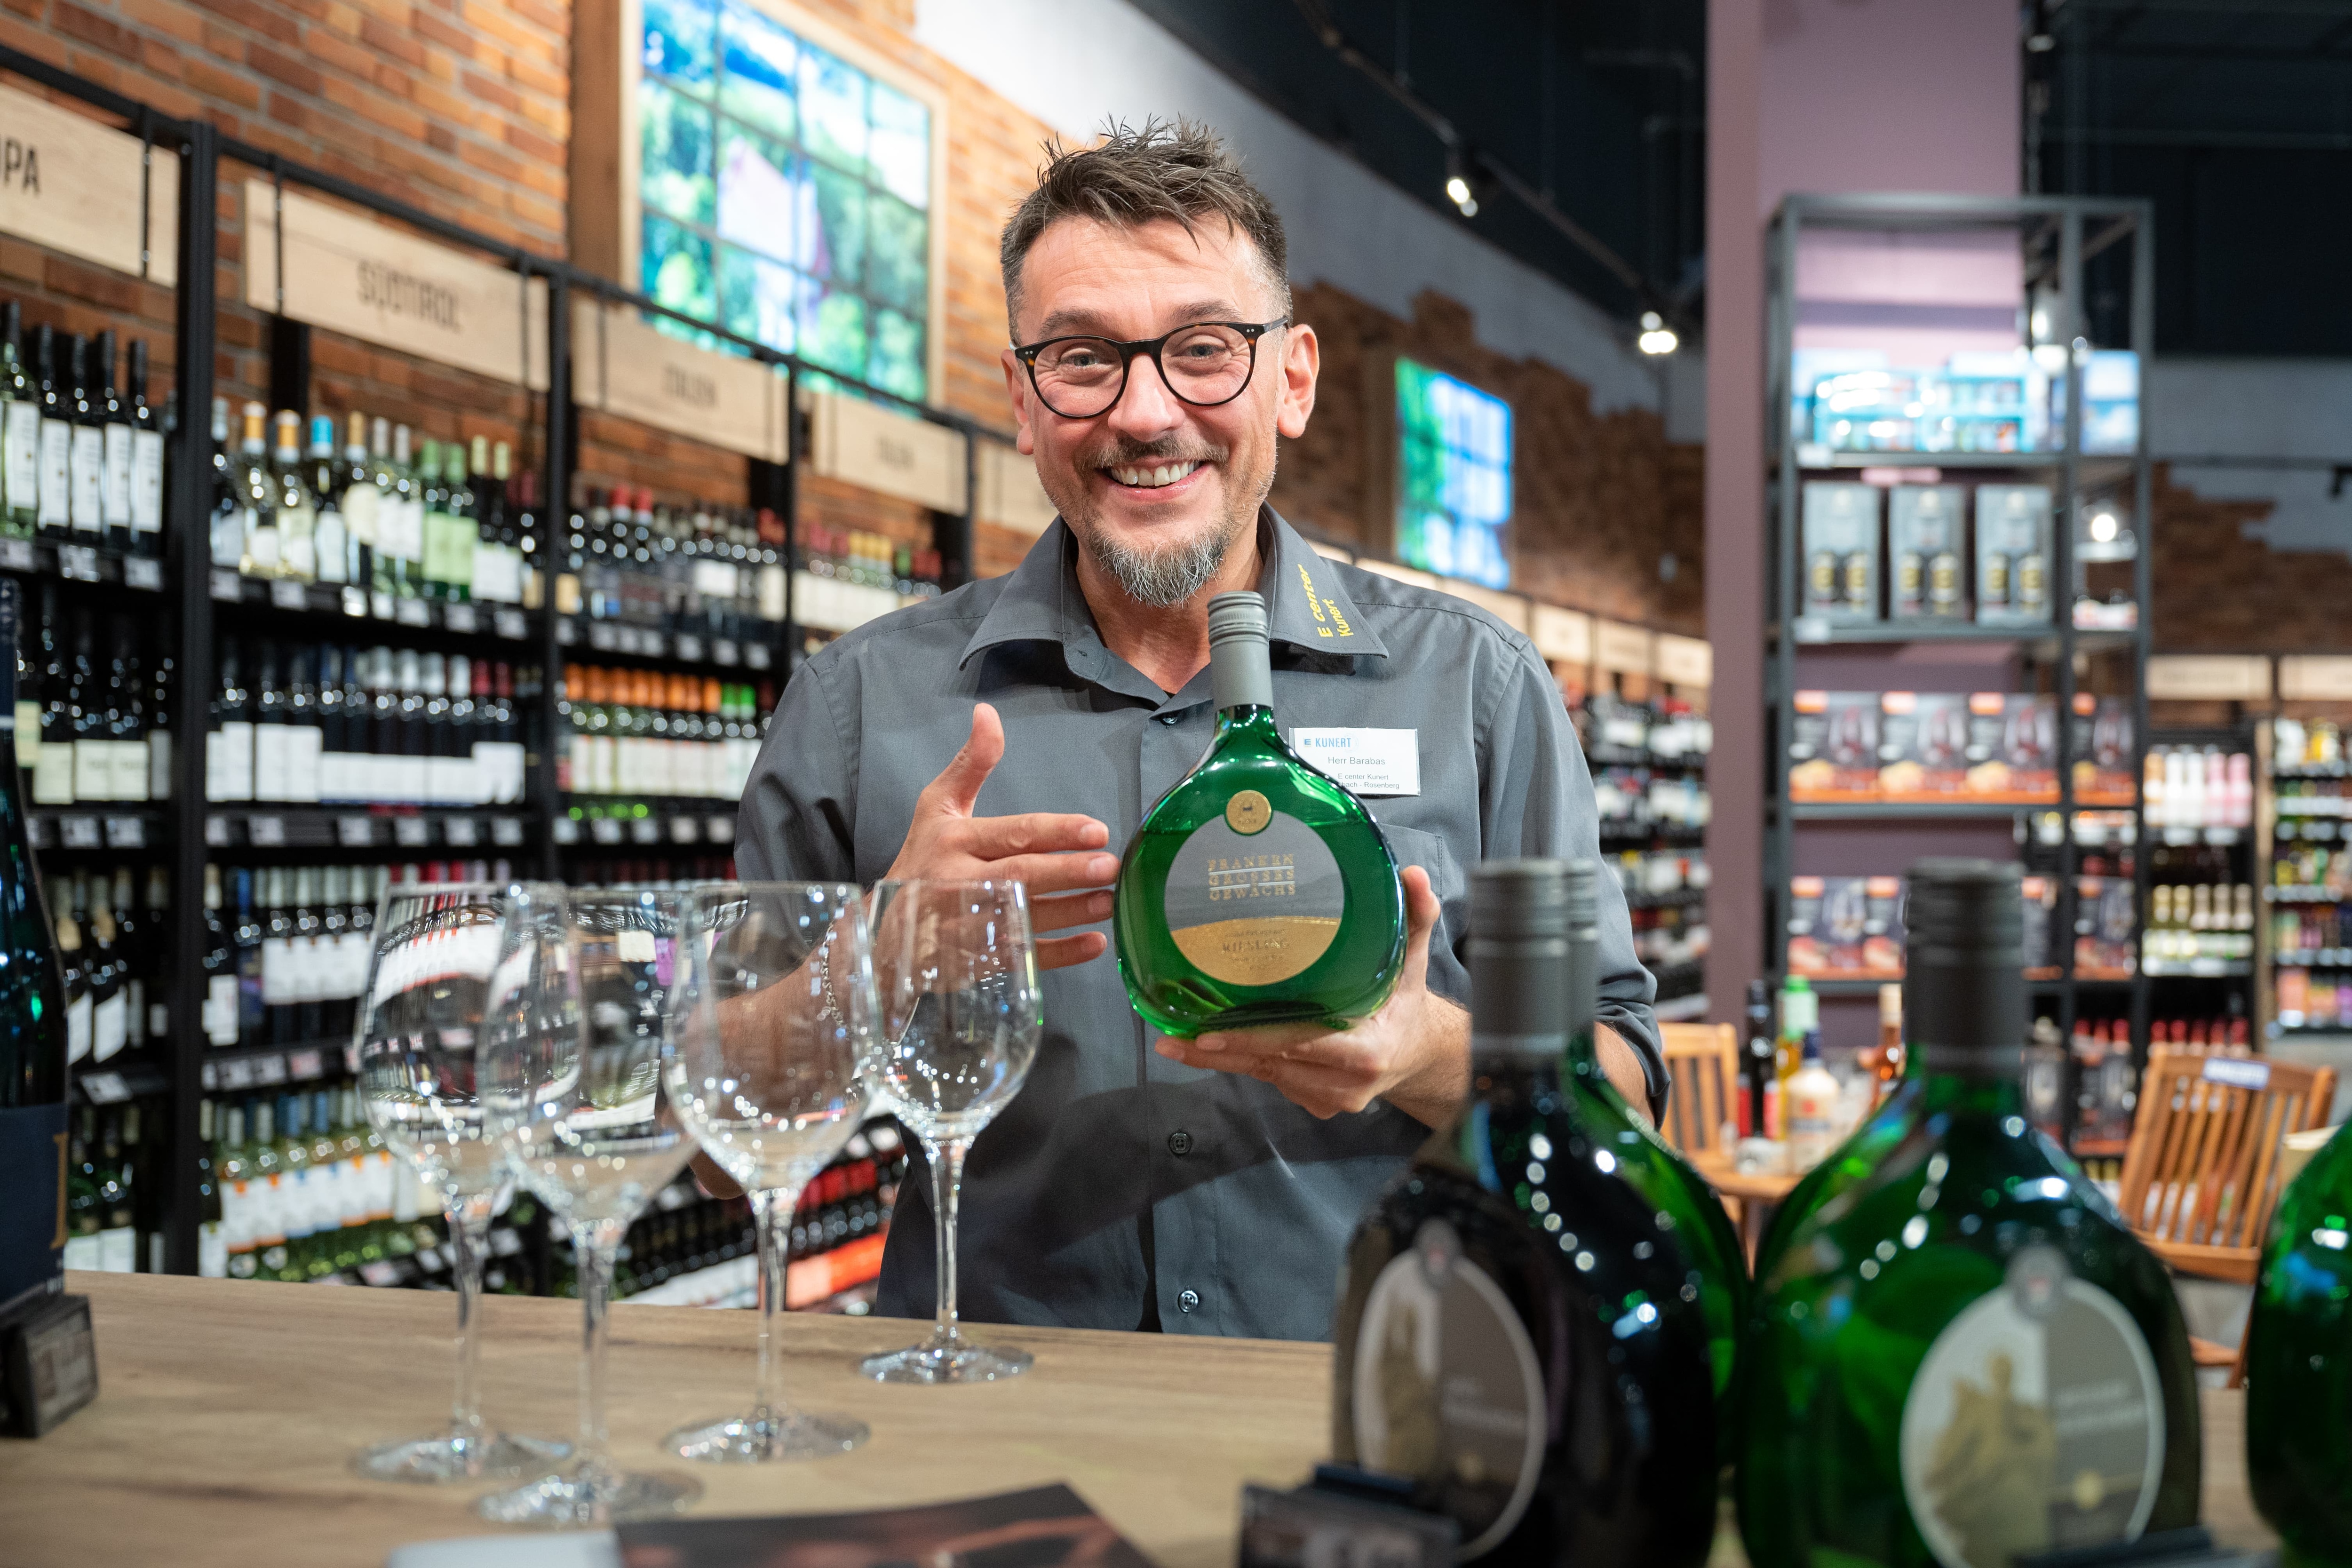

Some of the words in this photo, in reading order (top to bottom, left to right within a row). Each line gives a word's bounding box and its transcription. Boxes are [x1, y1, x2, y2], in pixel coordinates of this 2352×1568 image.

[0, 136, 41, 196] PA
[1297, 564, 1326, 622] center
[1322, 599, 1354, 637] Kunert
[1317, 627, 1334, 637] E
[1315, 737, 1351, 748] KUNERT
[1350, 756, 1386, 765] Barabas
[1364, 781, 1399, 790] Rosenberg
[1208, 853, 1294, 871] FRANKEN
[1208, 870, 1294, 886] GROSSES
